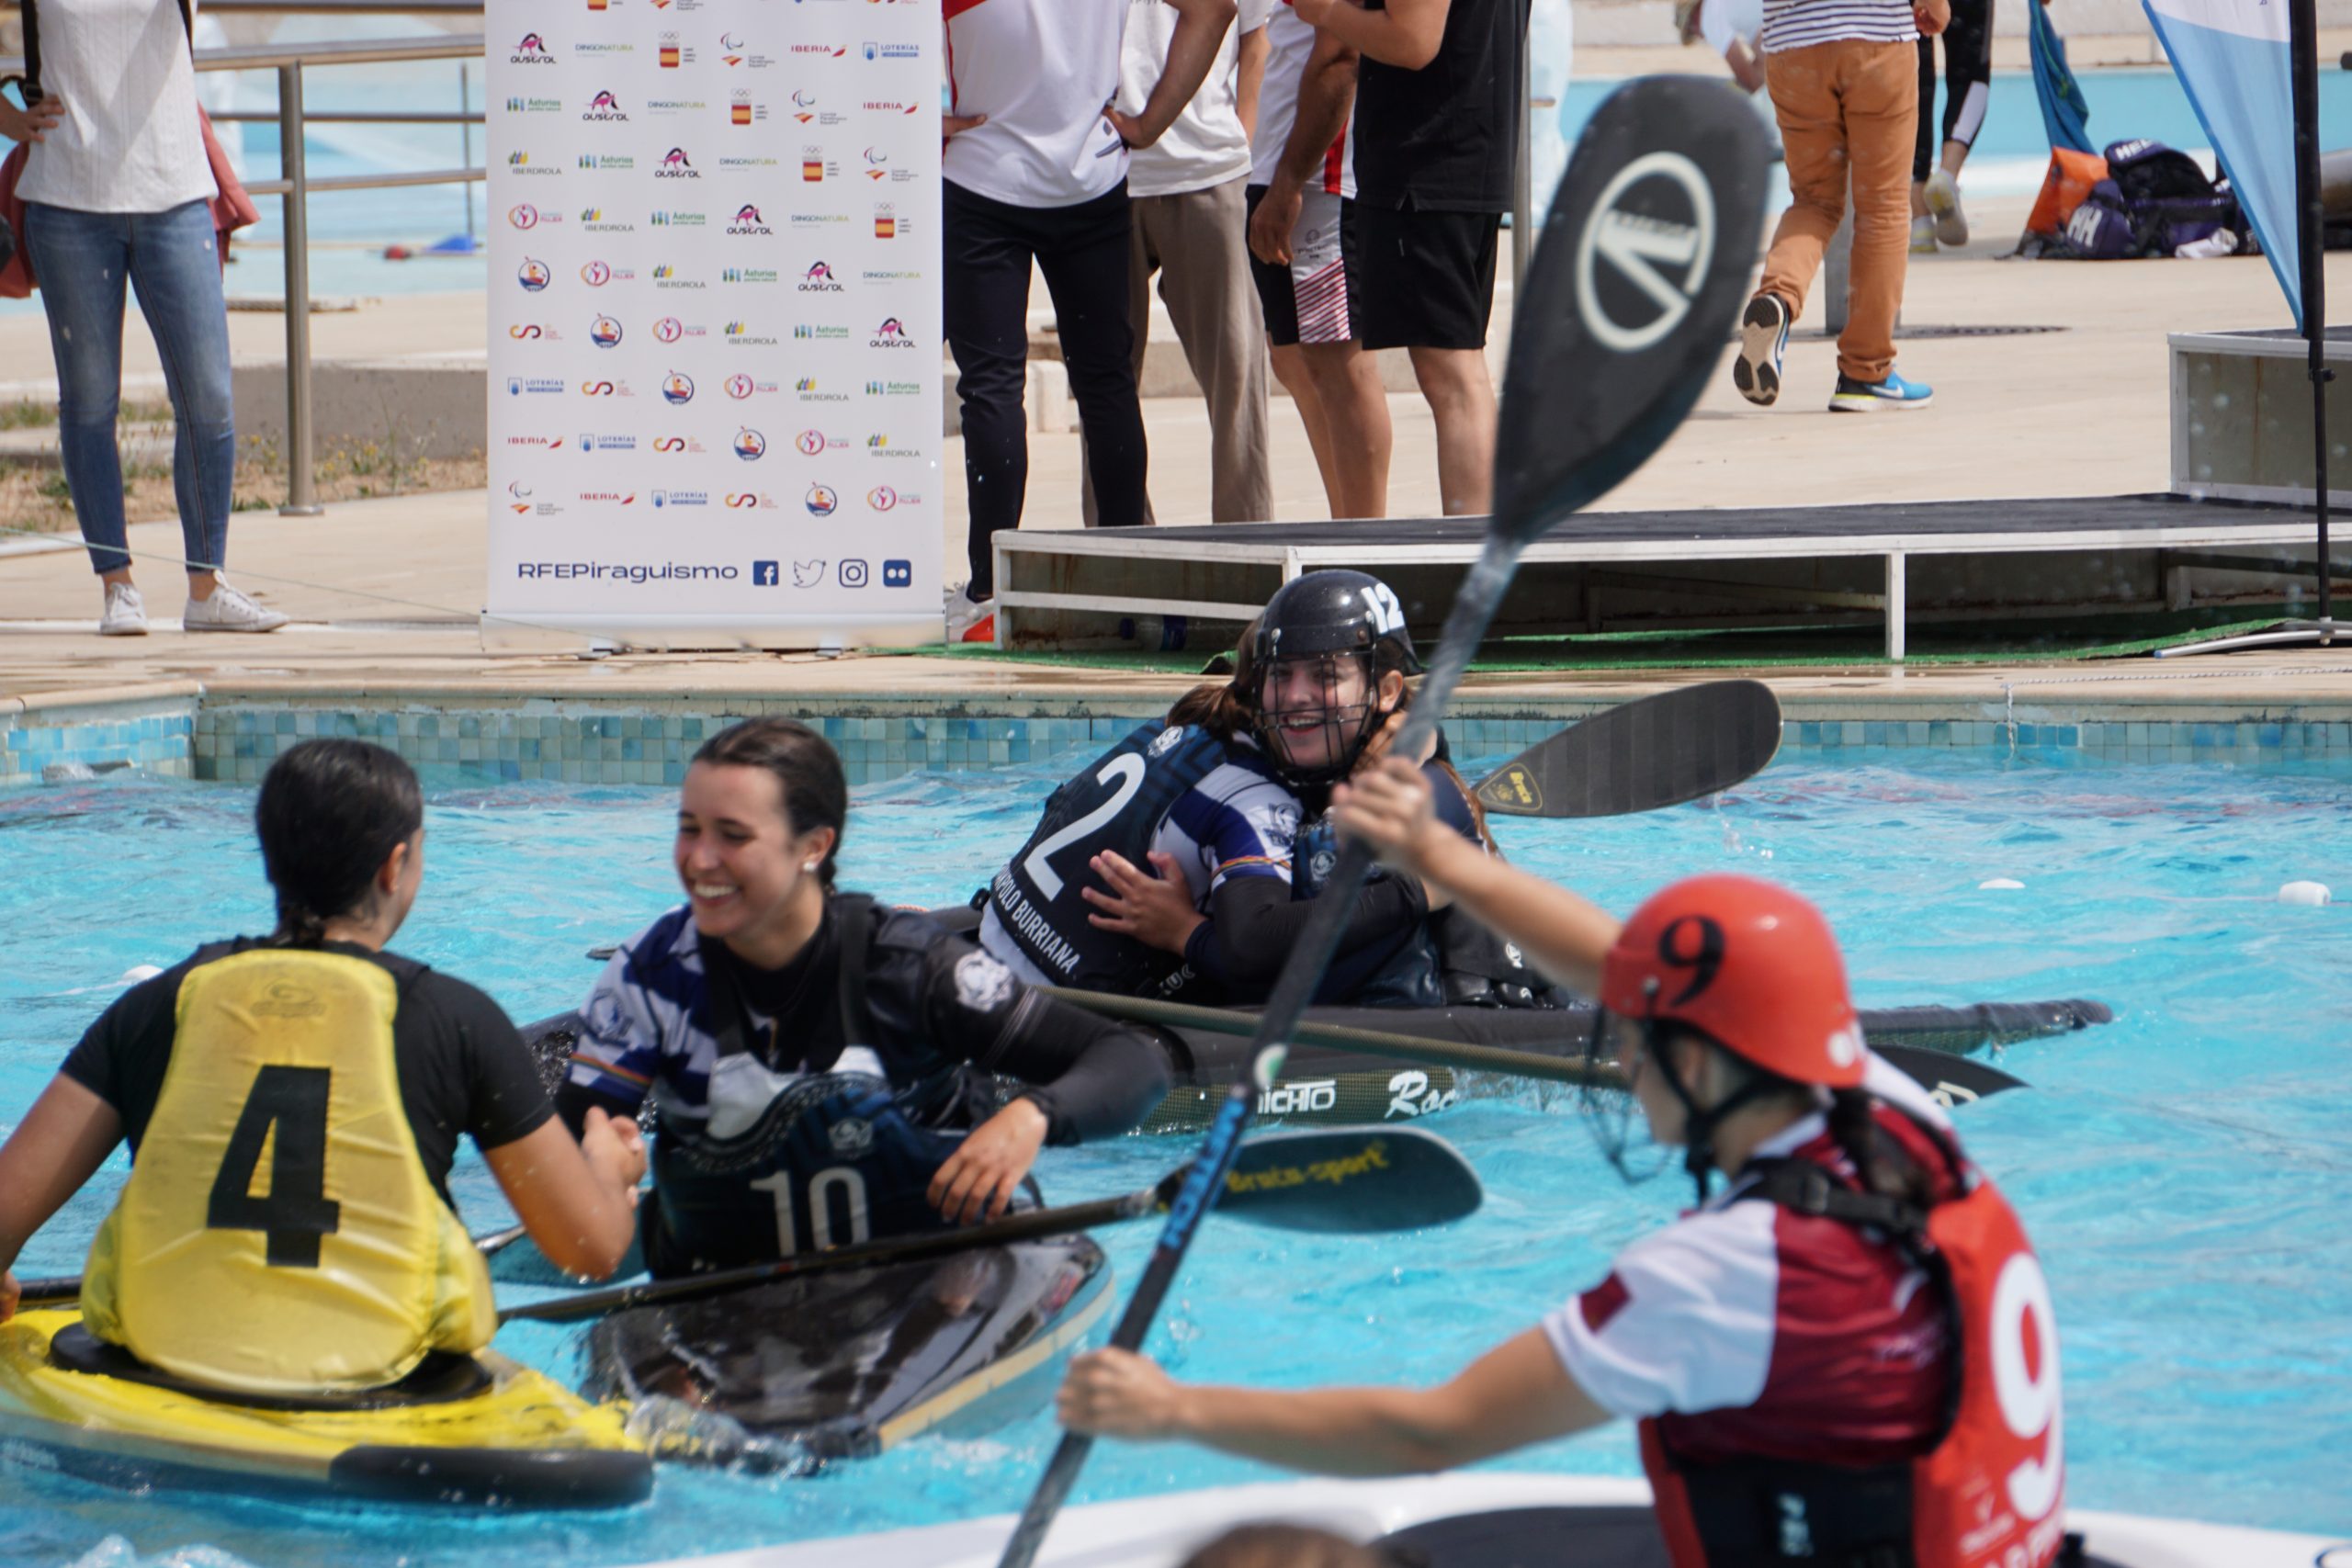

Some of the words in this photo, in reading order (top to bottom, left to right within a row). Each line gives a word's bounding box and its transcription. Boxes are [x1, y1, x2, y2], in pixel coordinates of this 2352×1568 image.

[512, 167, 563, 175] IBERDROLA
[799, 392, 850, 401] IBERDROLA
[871, 449, 922, 457] IBERDROLA
[518, 561, 739, 582] RFEPiraguismo
[1361, 582, 1406, 634] 12
[1023, 752, 1146, 902] 2
[1012, 902, 1081, 975] BURRIANA
[1658, 915, 1725, 1010] 9
[207, 1064, 340, 1269] 4
[750, 1167, 869, 1258] 10
[1988, 1252, 2066, 1521] 9
